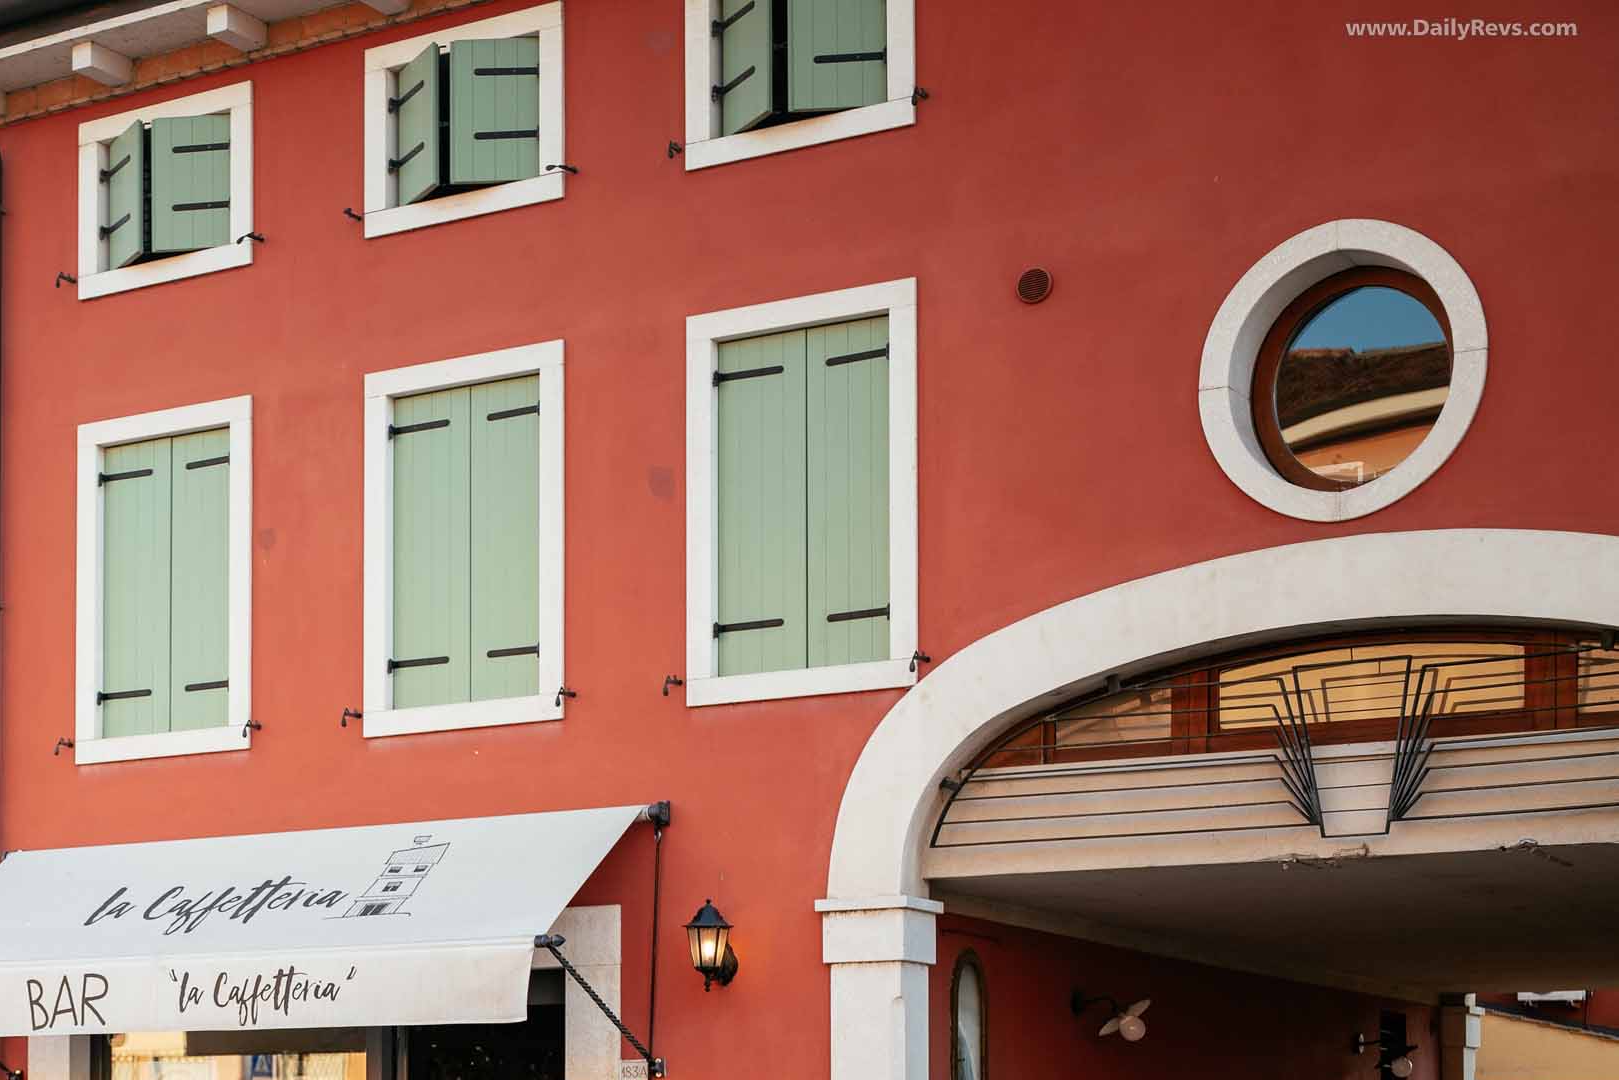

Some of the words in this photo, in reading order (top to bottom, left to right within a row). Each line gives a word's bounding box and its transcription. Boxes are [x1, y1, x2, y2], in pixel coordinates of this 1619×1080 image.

[83, 886, 136, 926] la
[143, 875, 349, 936] Caffetteria
[26, 973, 109, 1031] BAR
